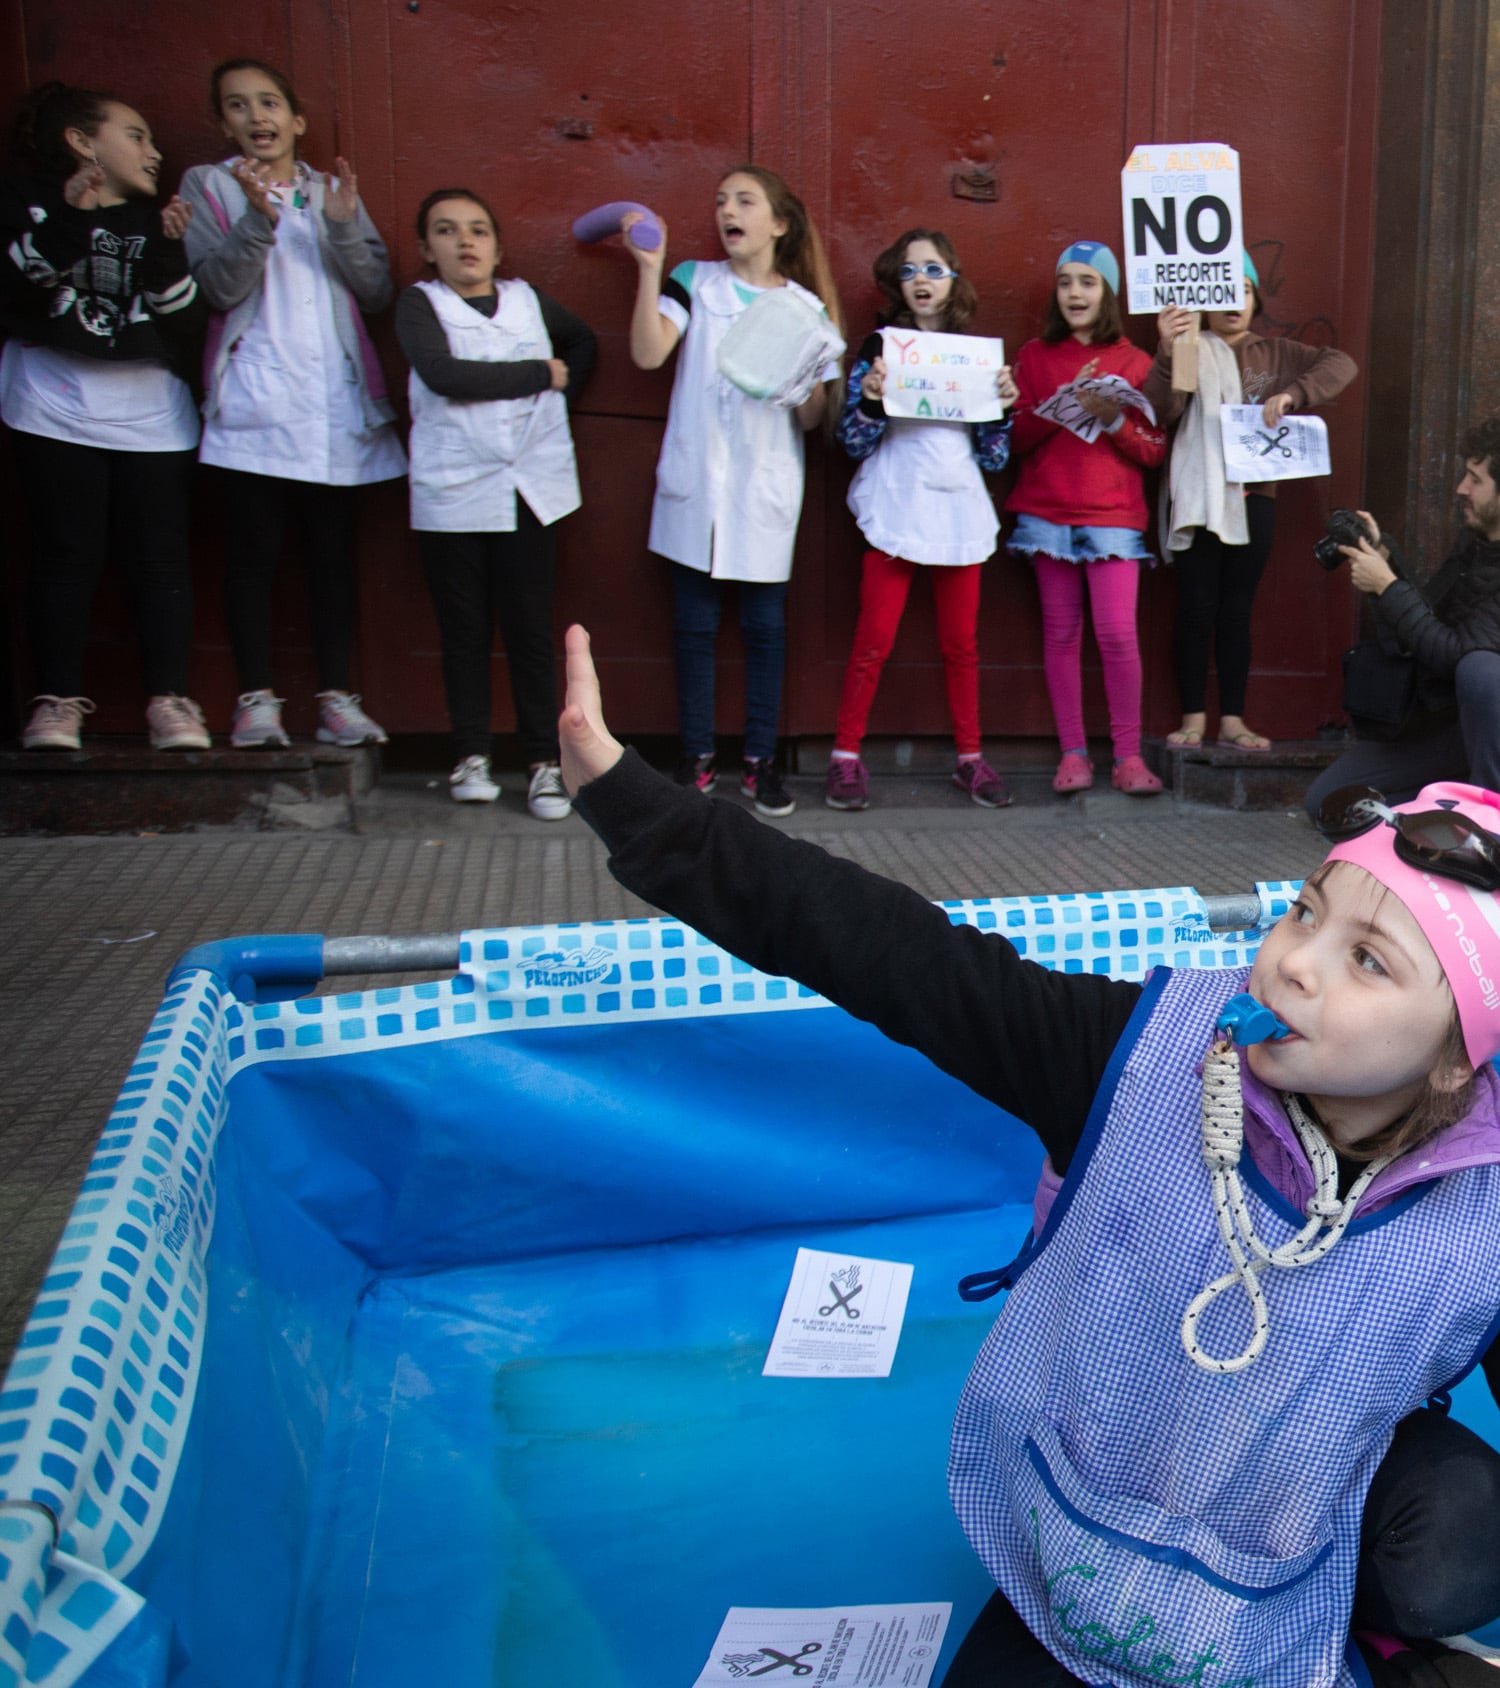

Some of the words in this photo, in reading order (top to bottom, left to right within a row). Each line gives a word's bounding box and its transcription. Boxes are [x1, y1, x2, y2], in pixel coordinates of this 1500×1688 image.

[1125, 154, 1157, 172] EL
[1165, 152, 1234, 171] ALVA
[1151, 174, 1208, 193] DICE
[1131, 195, 1232, 256] NO
[1155, 262, 1232, 283] RECORTE
[1154, 284, 1236, 306] NATACION
[1174, 926, 1216, 944] PELOPIN
[524, 963, 608, 990] PELOPINCHO
[1030, 1507, 1257, 1688] Violet
